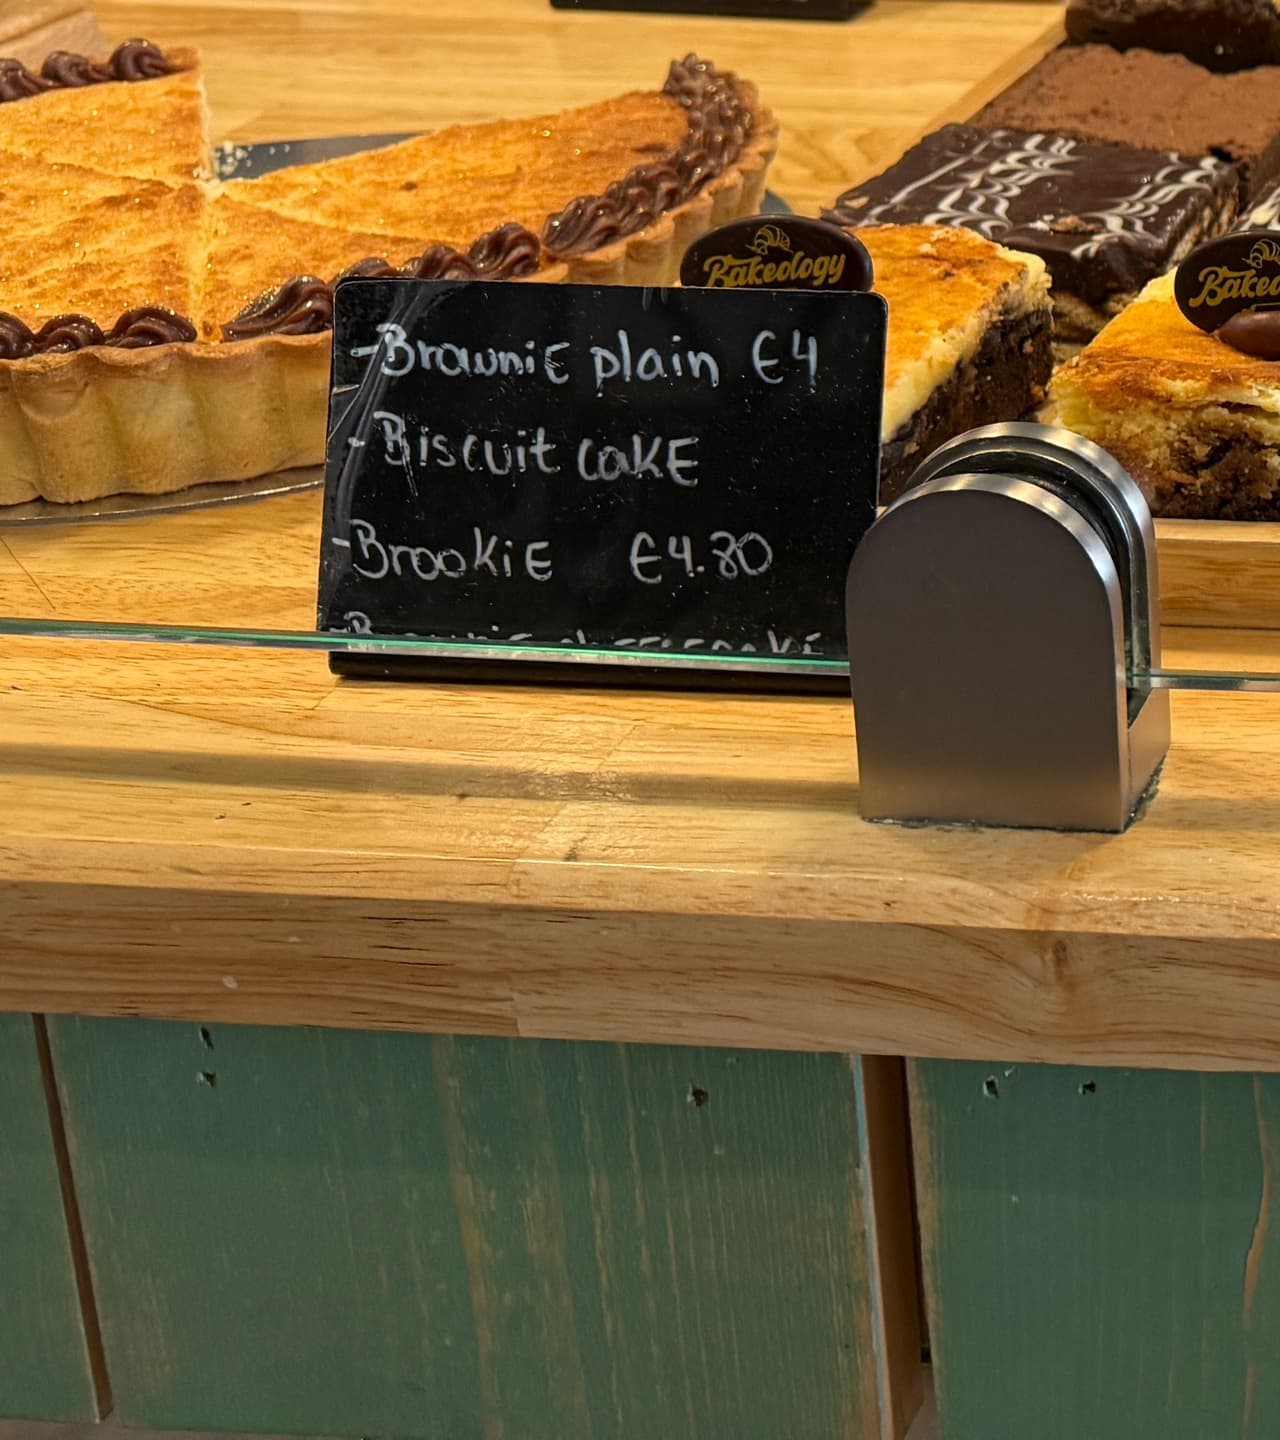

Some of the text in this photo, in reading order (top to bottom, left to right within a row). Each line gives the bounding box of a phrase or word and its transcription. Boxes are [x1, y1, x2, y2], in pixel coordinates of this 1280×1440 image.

[703, 250, 846, 288] Bakeology
[591, 330, 720, 396] plain
[752, 329, 819, 388] €4
